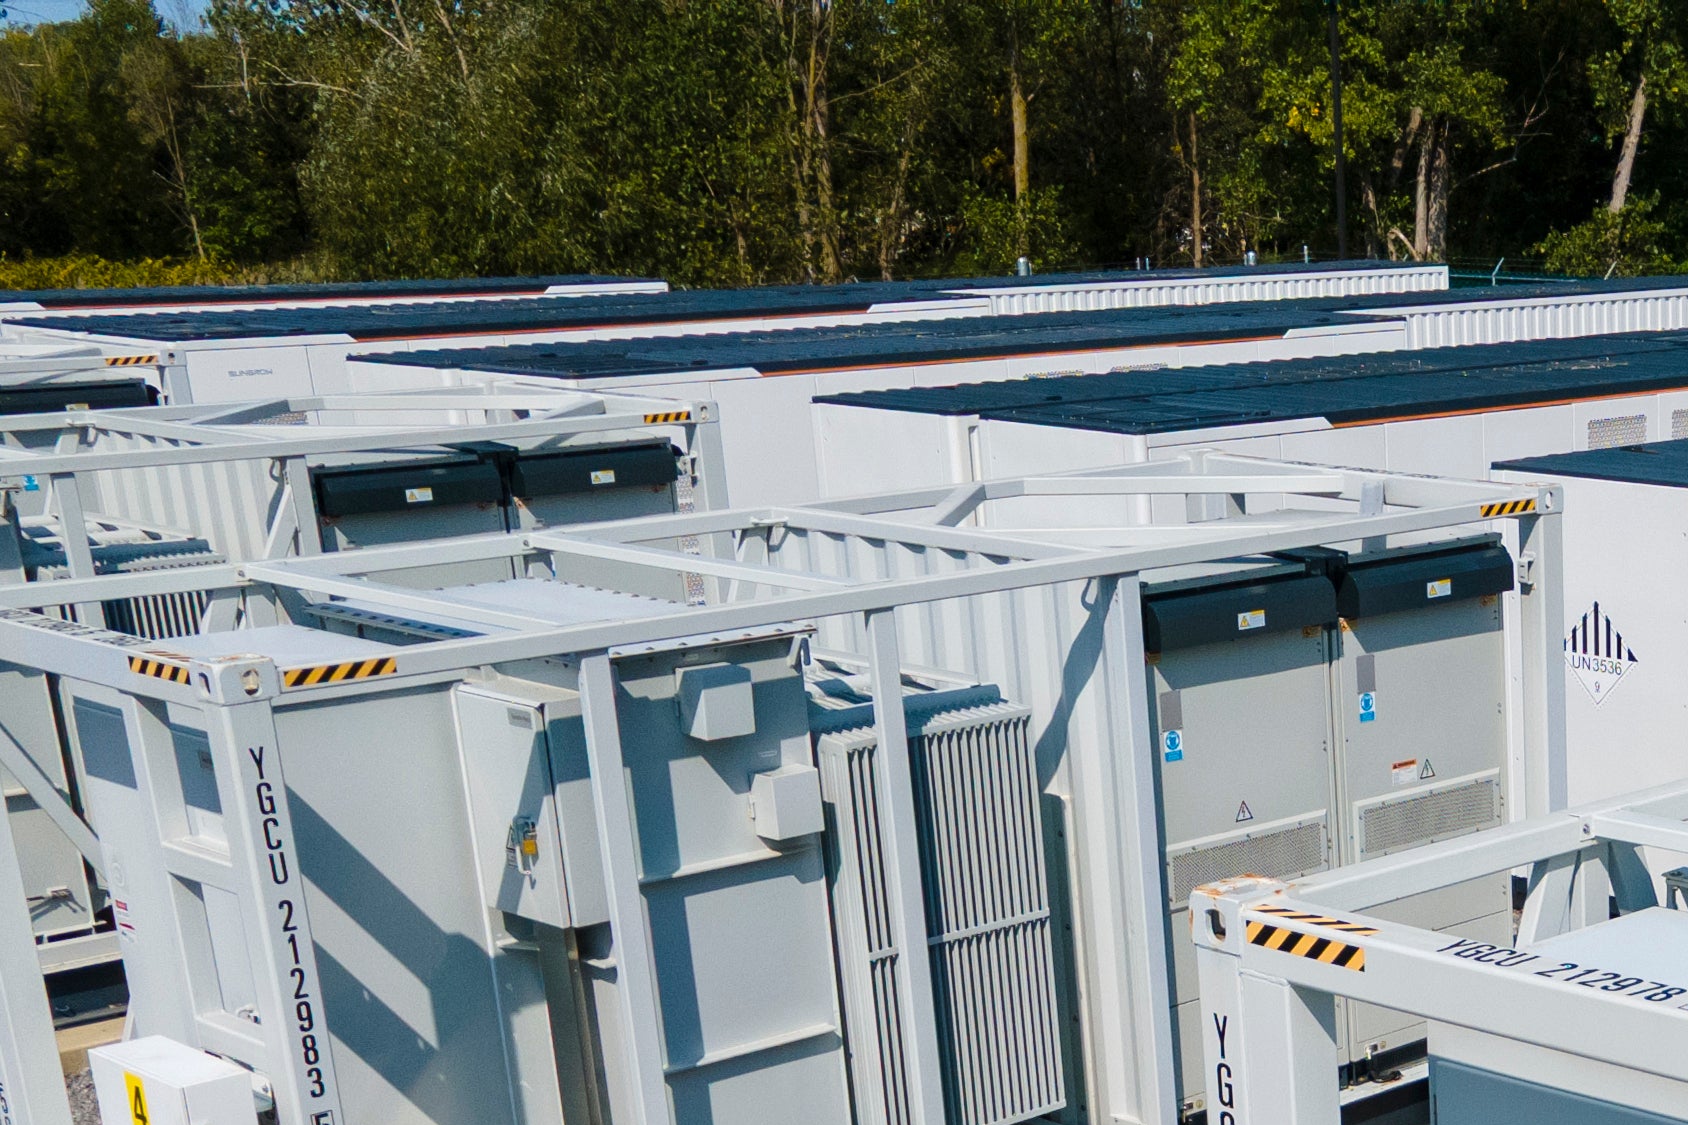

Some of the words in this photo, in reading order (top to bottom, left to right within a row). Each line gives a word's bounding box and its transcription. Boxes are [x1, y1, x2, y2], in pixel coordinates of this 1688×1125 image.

[1572, 655, 1622, 676] UN3536
[248, 746, 289, 885] YGCU
[278, 899, 326, 1099] 212983
[1437, 939, 1530, 968] YGCU
[1534, 962, 1688, 1002] 212978
